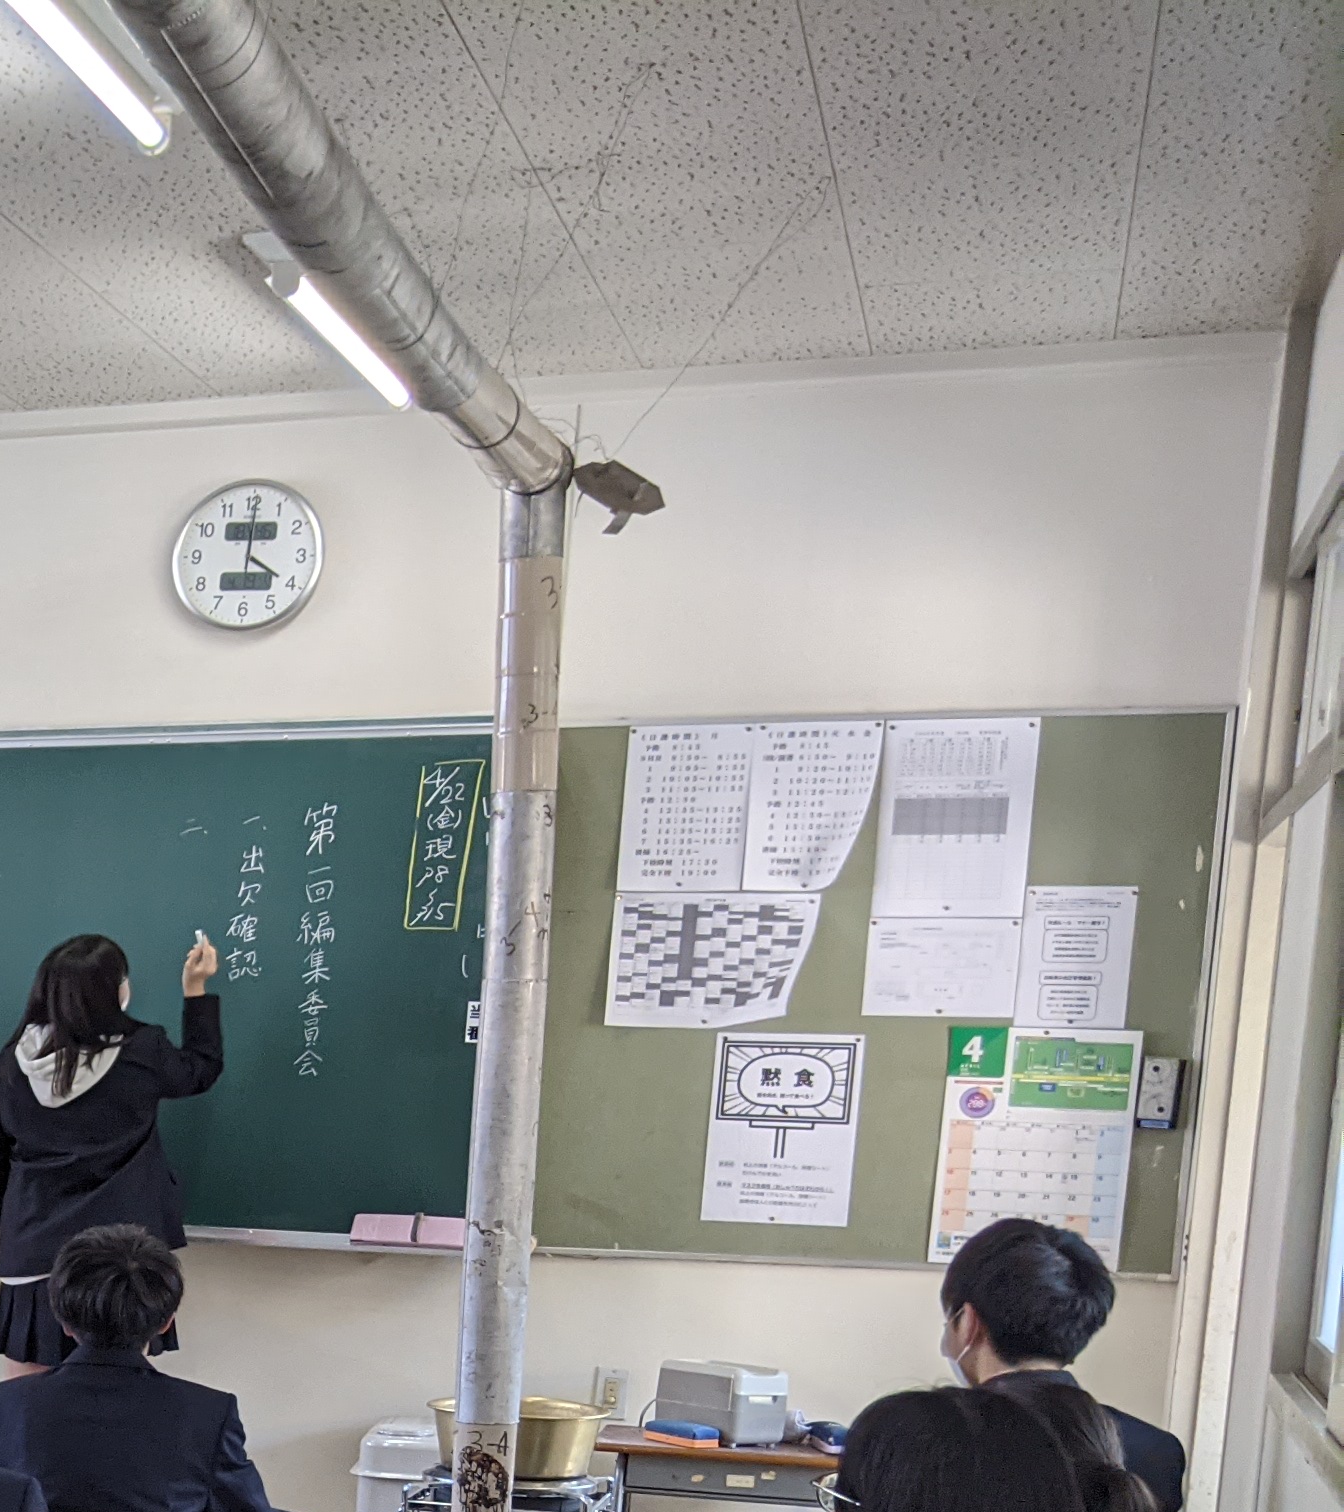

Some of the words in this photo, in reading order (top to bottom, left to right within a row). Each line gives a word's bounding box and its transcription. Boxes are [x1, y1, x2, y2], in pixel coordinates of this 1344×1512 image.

[246, 494, 262, 511] 12
[276, 503, 282, 517] 1
[221, 504, 234, 518] 11
[199, 522, 215, 538] 10
[291, 520, 302, 535] 2
[191, 549, 202, 564] 9
[296, 548, 307, 564] 3
[195, 576, 206, 592] 8
[285, 575, 296, 591] 4
[213, 595, 224, 610] 7
[237, 601, 248, 617] 6
[265, 595, 276, 610] 5
[293, 802, 338, 1077] 第一回編集委員会
[961, 1035, 984, 1063] 4
